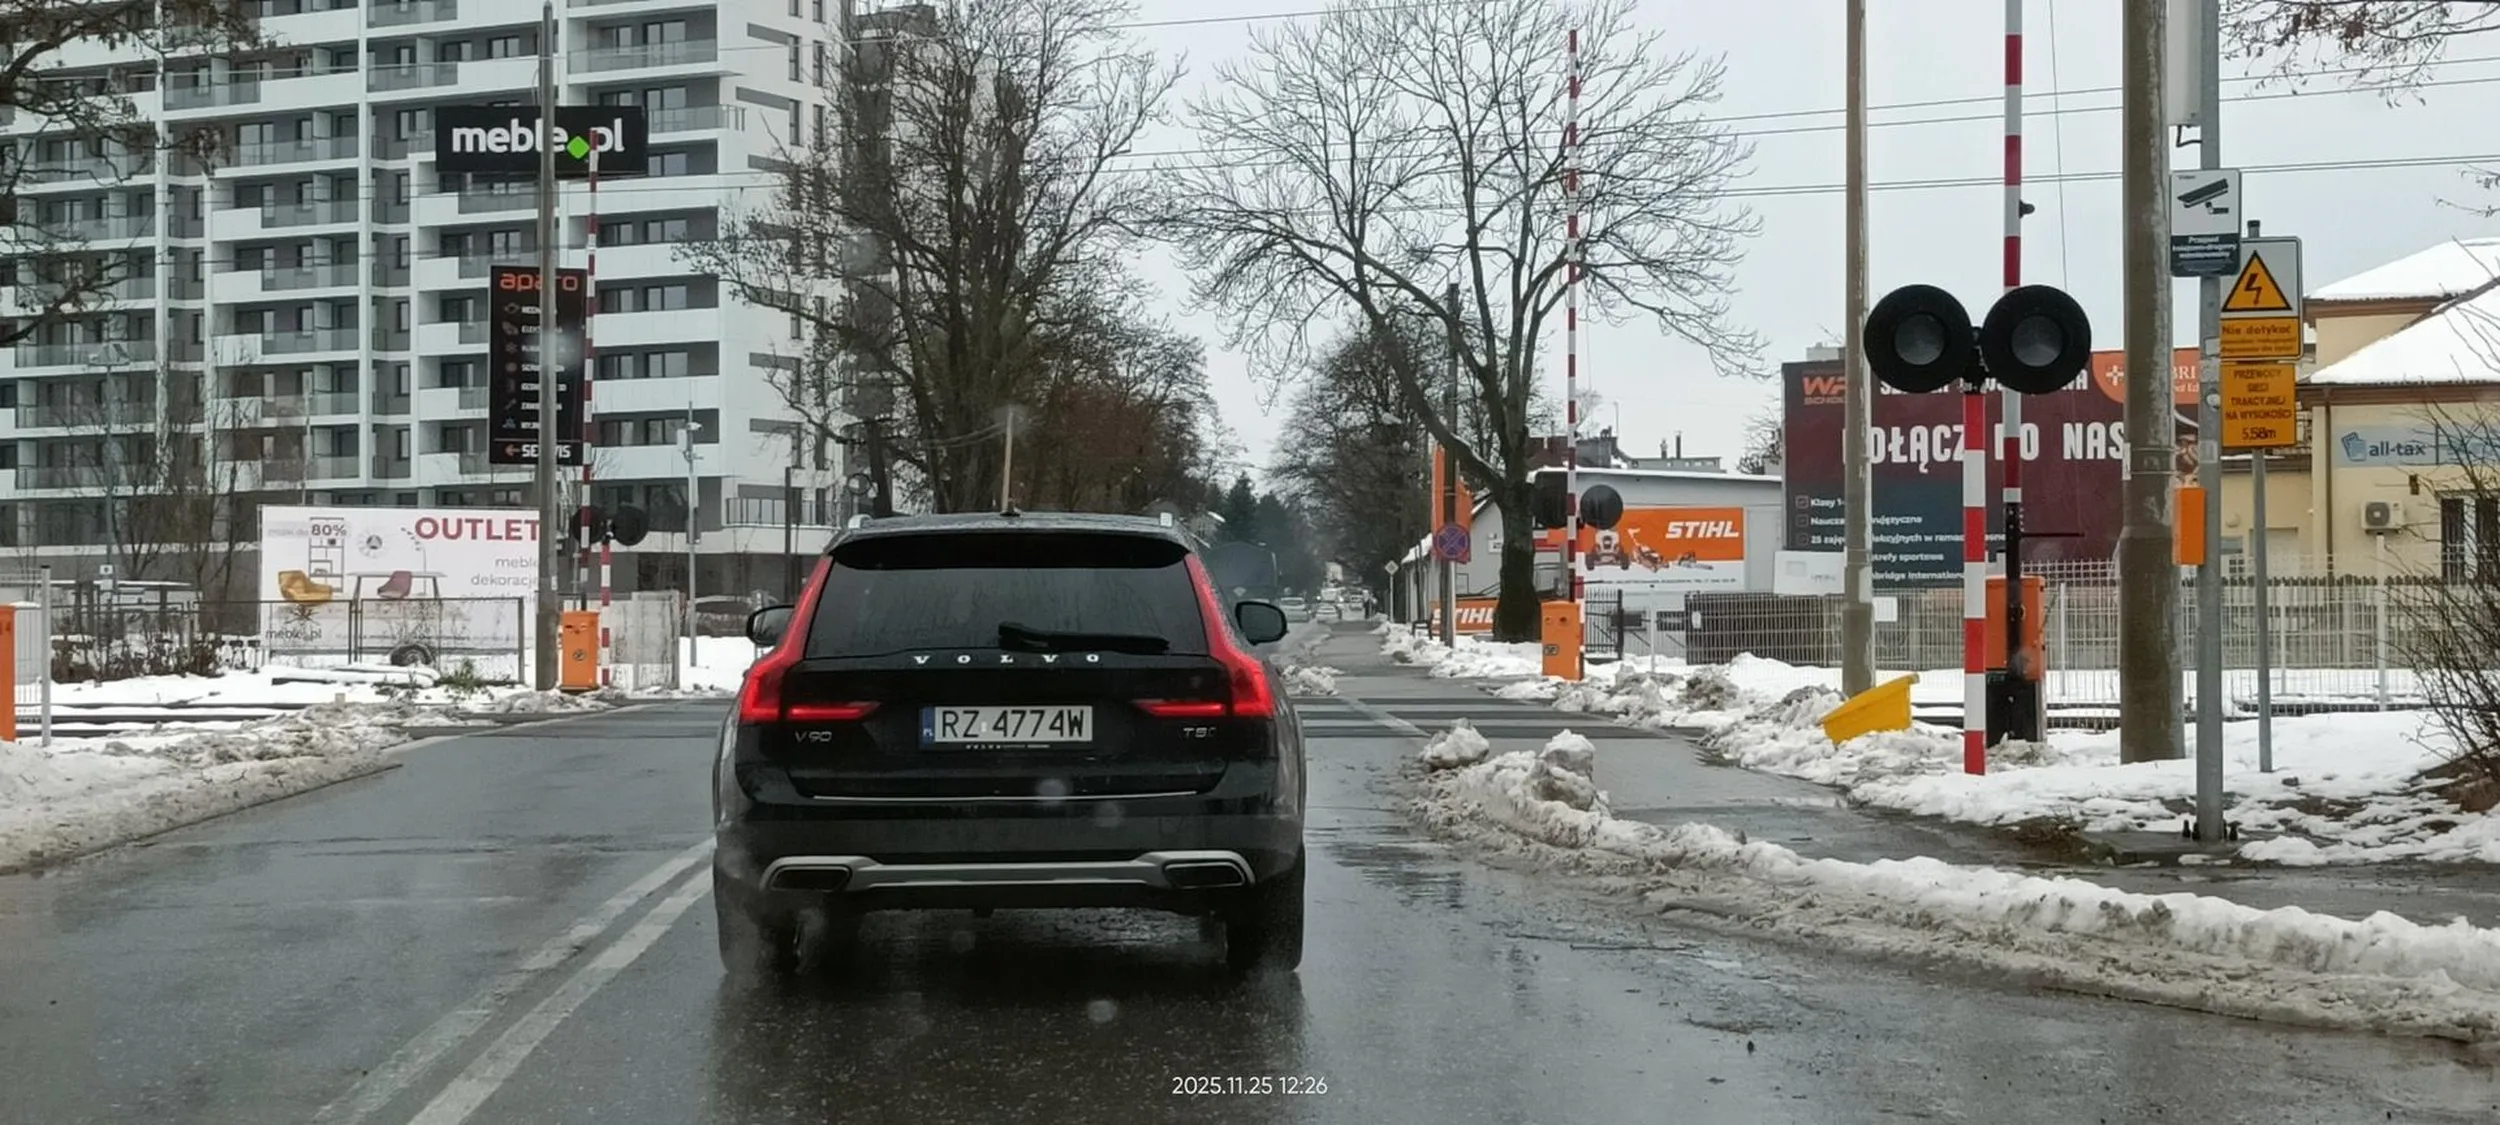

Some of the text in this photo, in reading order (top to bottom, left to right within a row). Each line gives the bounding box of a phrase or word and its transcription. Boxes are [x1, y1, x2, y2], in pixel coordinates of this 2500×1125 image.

[501, 273, 578, 292] apao
[521, 444, 572, 458] SEIS
[1843, 424, 1964, 473] OŁĄCZ
[2368, 441, 2427, 457] all-tax
[311, 523, 346, 537] 80%
[415, 517, 540, 541] OUTLET
[1665, 520, 1739, 539] STIHL
[913, 653, 1100, 665] VOLVO
[942, 709, 1084, 738] RZ 4774W
